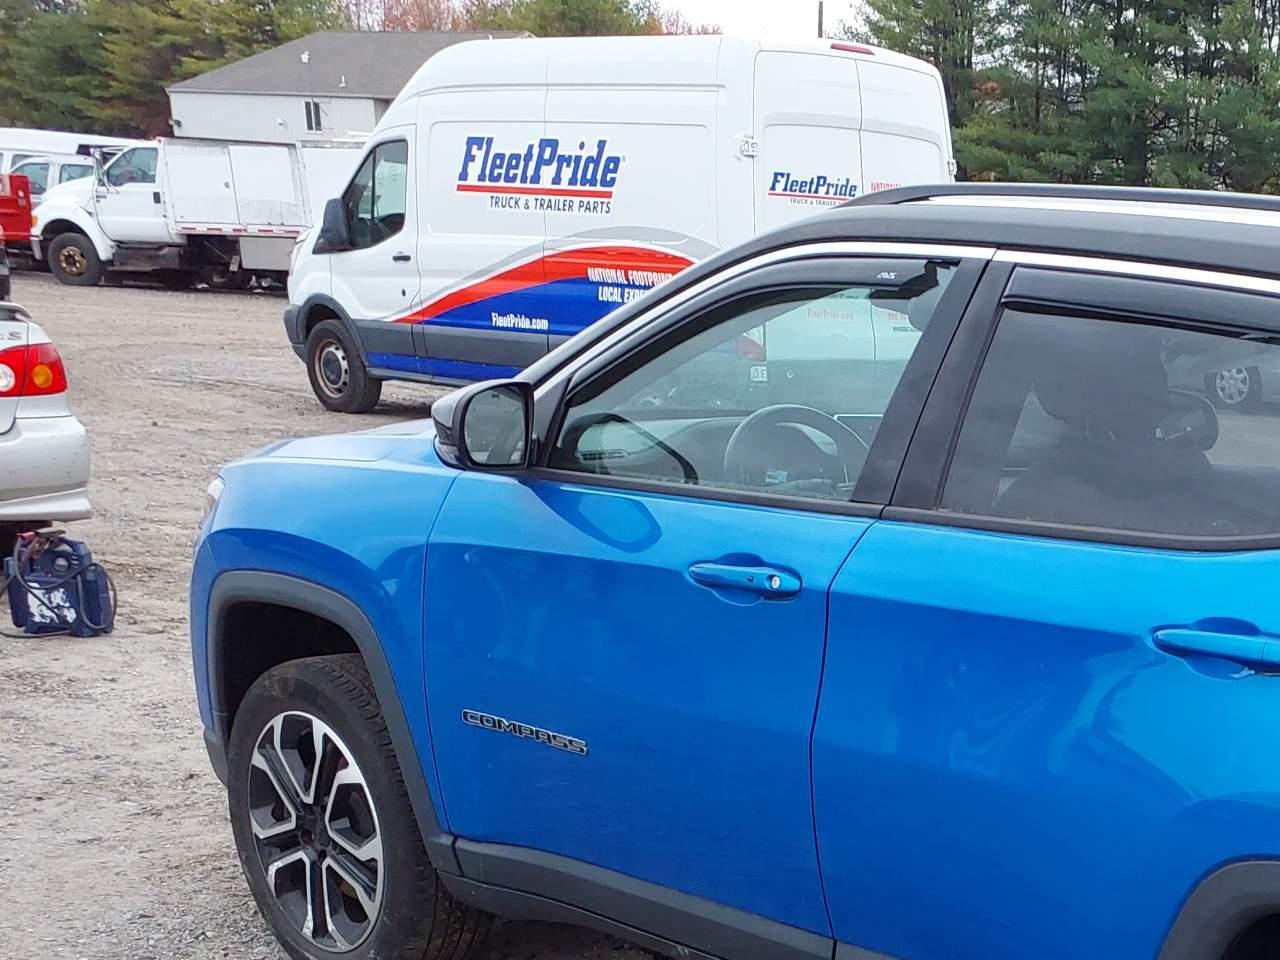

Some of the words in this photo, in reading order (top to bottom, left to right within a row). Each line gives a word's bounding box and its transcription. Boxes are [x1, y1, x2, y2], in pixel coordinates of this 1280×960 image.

[458, 137, 621, 187] FleetPride
[769, 172, 858, 197] FleetPride
[490, 196, 520, 209] TRUCK
[524, 199, 530, 210] &
[534, 198, 574, 212] TRAILER
[578, 201, 611, 214] PARTS
[588, 267, 628, 284] NATIONAL
[598, 286, 623, 302] LOCAL
[491, 312, 549, 330] FleetPride.com
[462, 708, 588, 756] COMPASS
